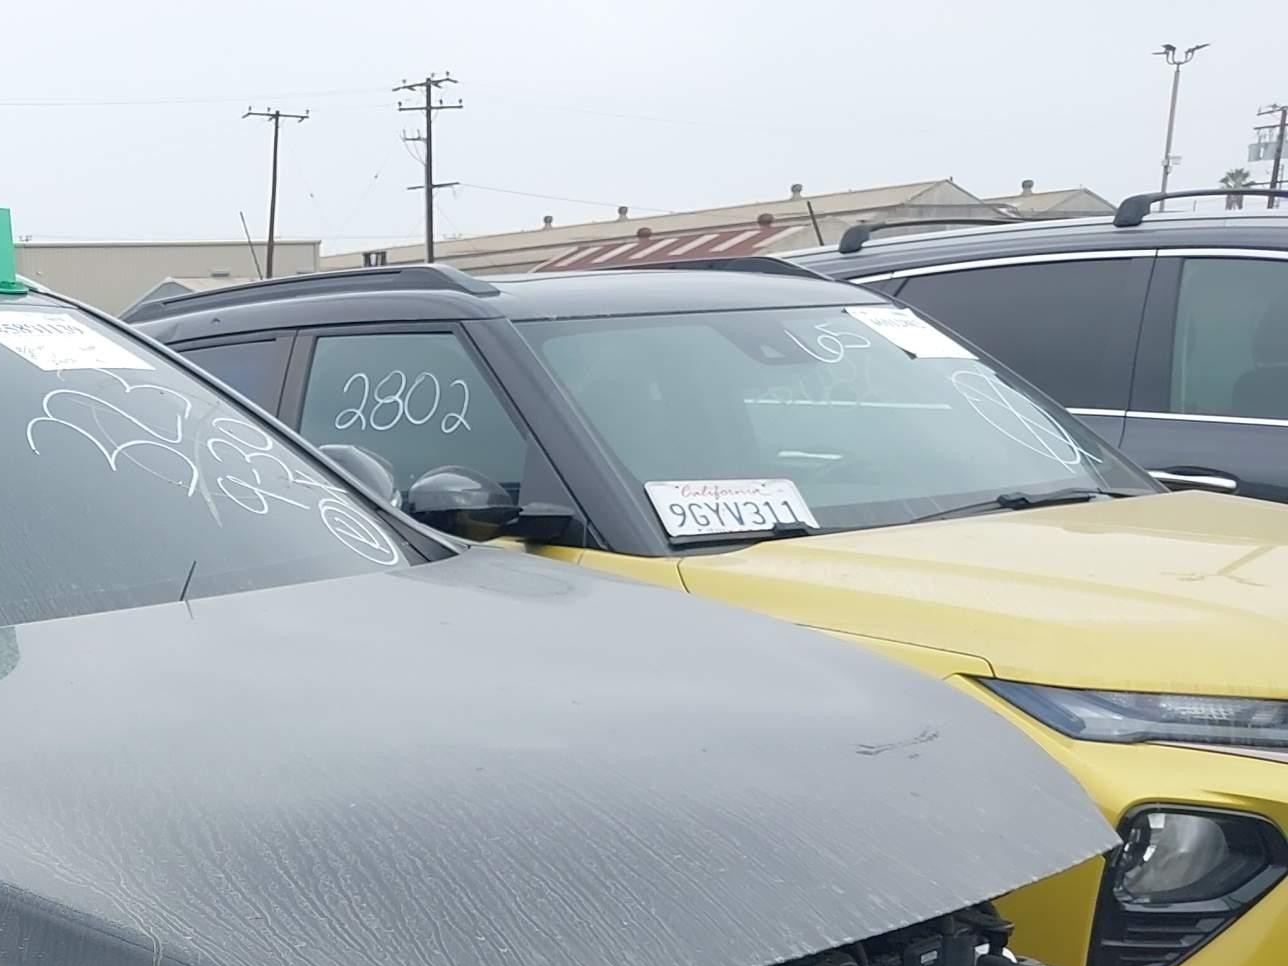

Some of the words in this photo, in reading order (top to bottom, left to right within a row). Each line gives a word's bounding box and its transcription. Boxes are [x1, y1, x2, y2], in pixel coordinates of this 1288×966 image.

[334, 369, 472, 434] 2802
[680, 484, 770, 500] California
[668, 500, 800, 528] 9GYV311
